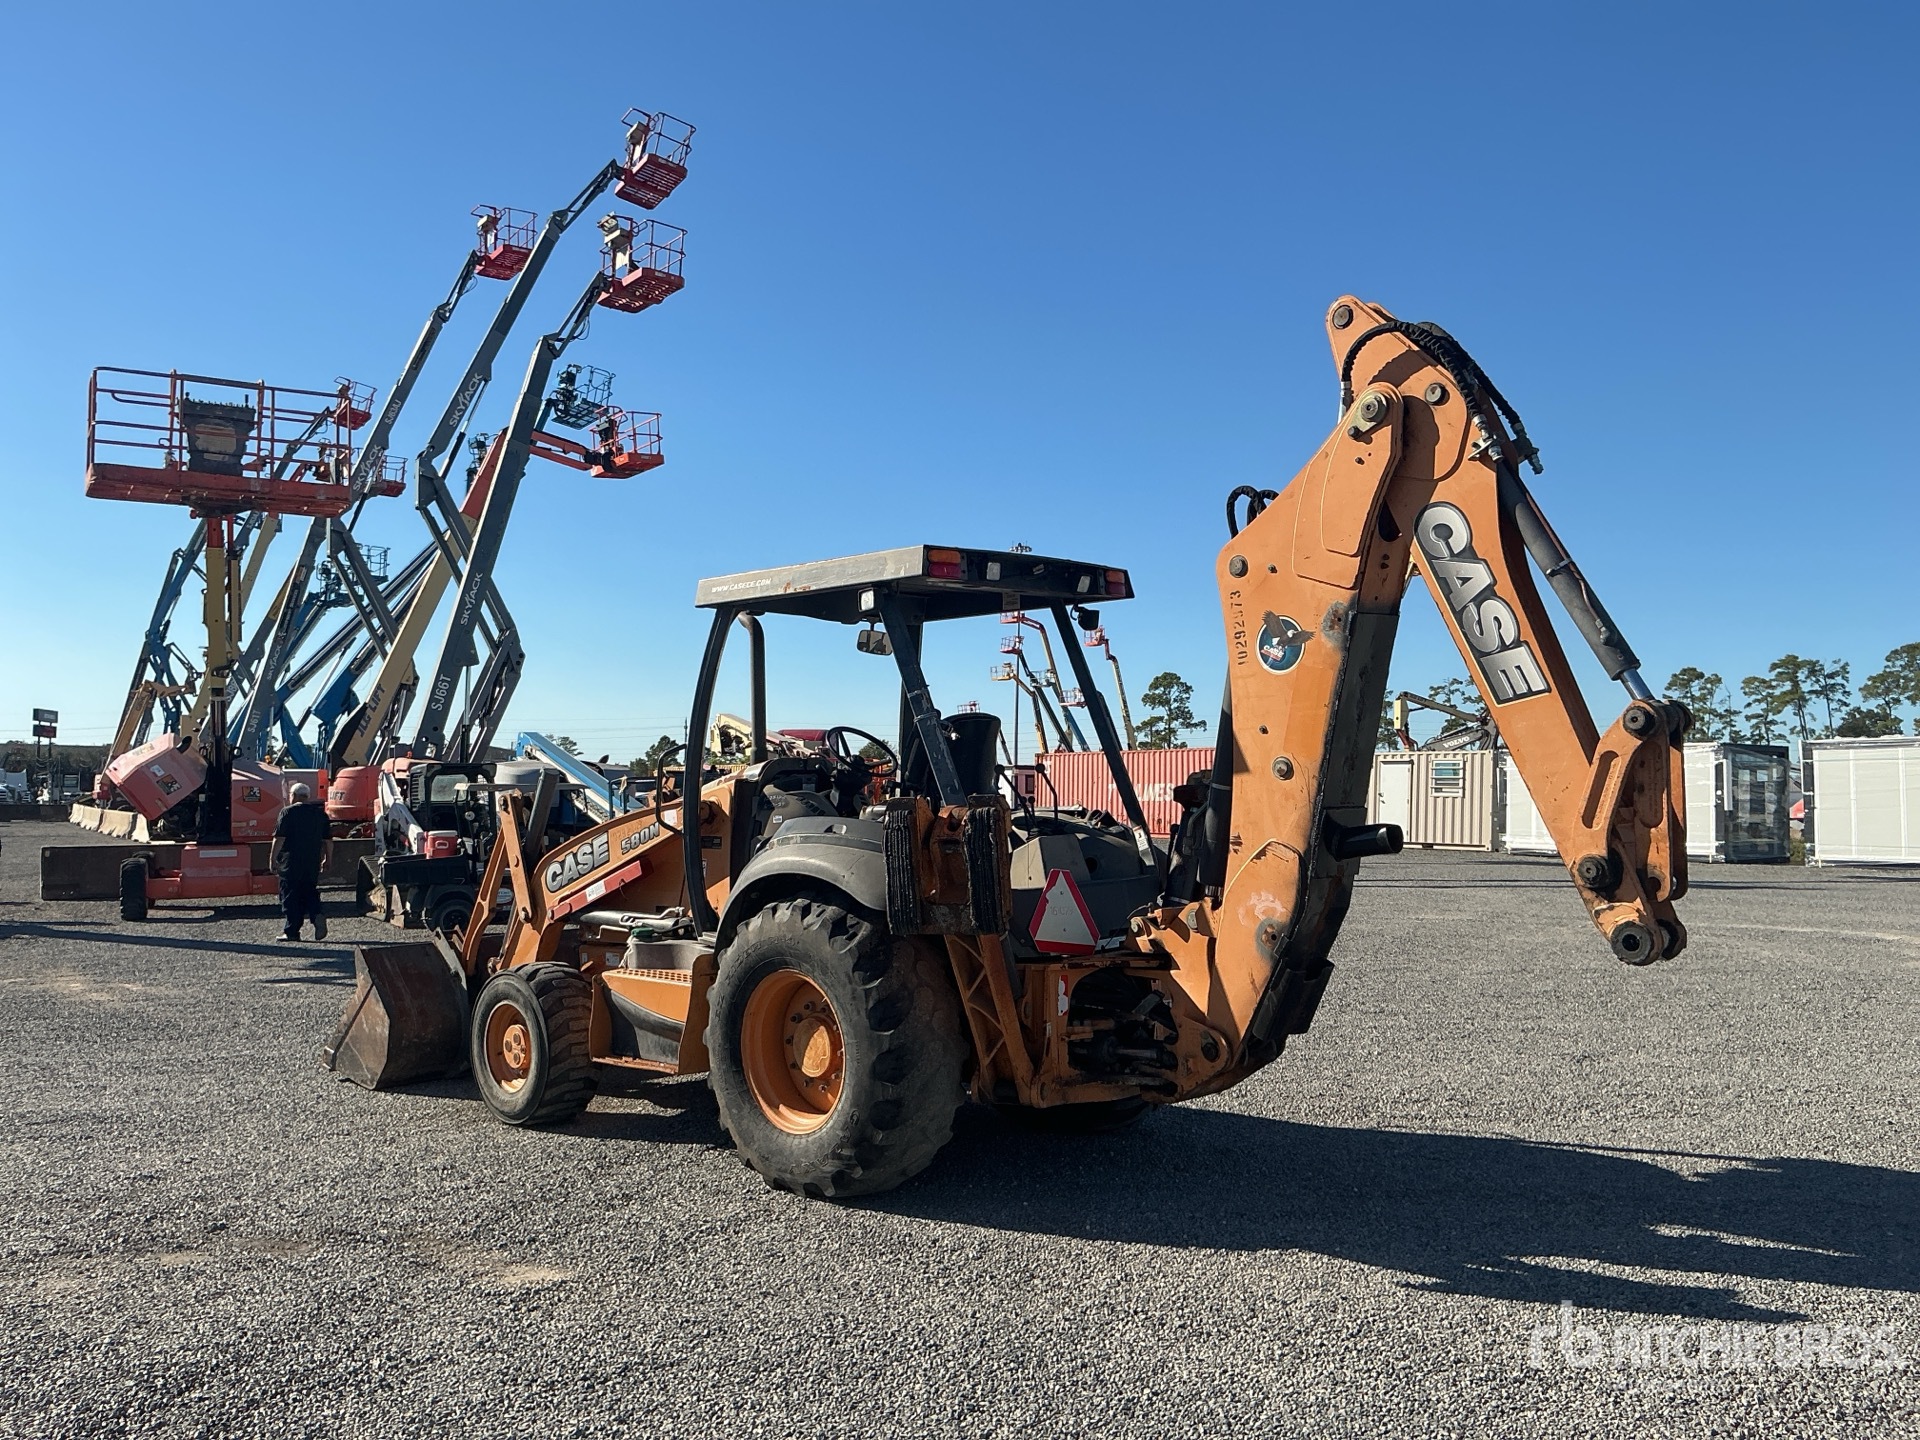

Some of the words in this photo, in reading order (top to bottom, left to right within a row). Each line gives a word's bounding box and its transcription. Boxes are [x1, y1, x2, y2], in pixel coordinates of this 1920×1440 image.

[449, 371, 484, 429] SKYJACK
[352, 443, 383, 493] SKYJACK
[460, 571, 484, 626] SKYJACK
[711, 577, 773, 594] WWW.CASECE.COM
[1416, 504, 1549, 702] CASE
[358, 713, 372, 738] JLG
[369, 684, 386, 712] LIFT
[431, 674, 452, 711] SJ66T
[1442, 736, 1470, 749] VOLVO
[545, 831, 610, 893] CASE
[621, 823, 660, 855] 580N
